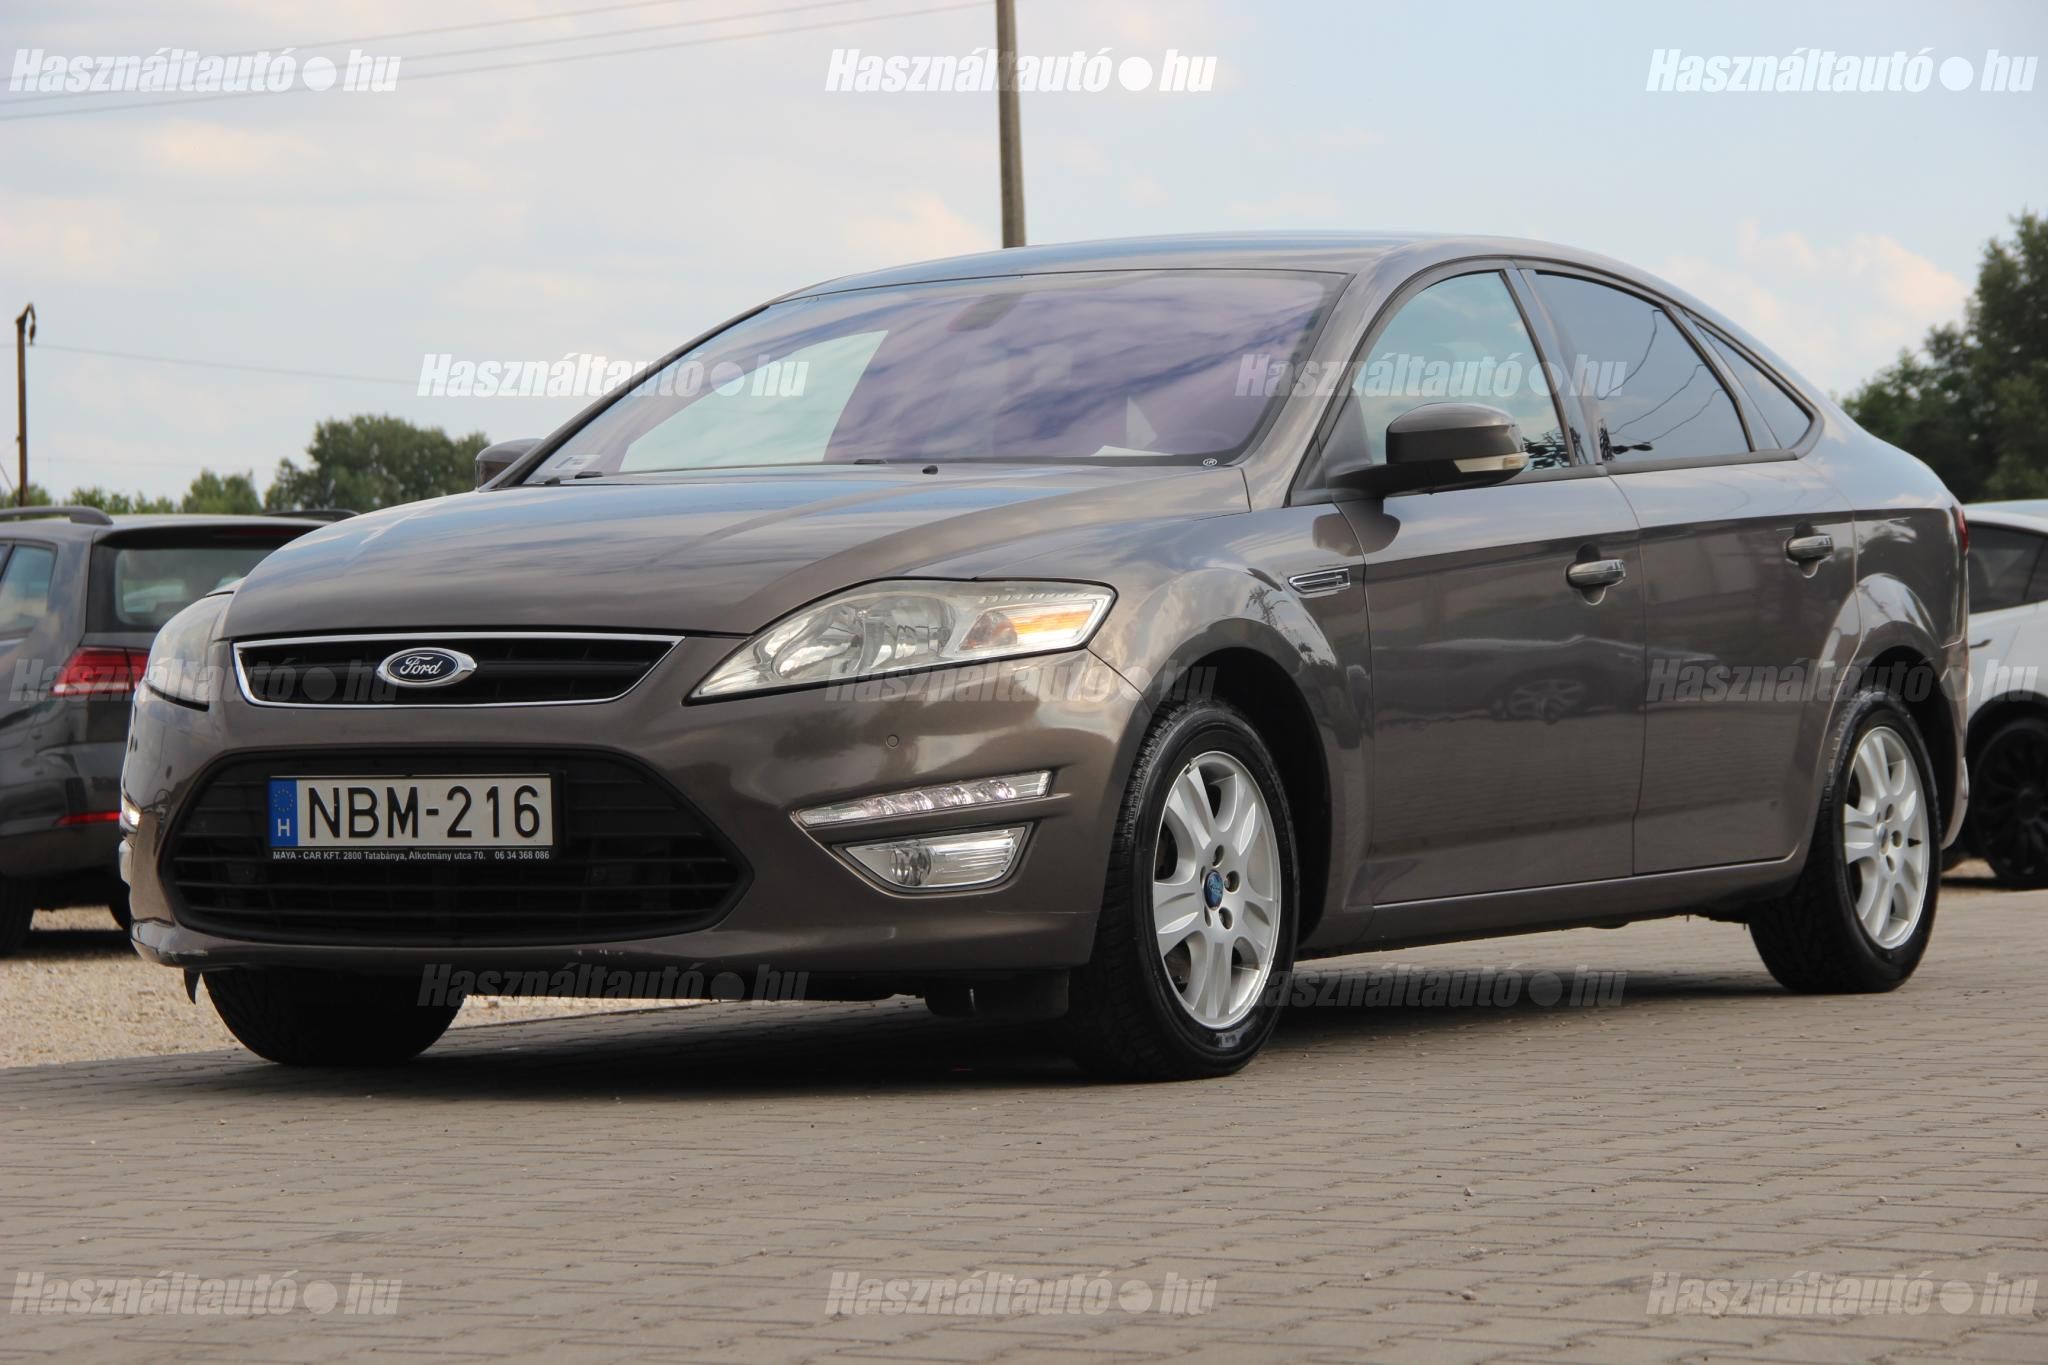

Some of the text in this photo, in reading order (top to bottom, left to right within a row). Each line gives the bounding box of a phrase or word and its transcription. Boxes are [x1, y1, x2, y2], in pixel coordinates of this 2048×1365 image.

[400, 656, 443, 675] Ford
[308, 785, 540, 838] NBM-216
[277, 818, 290, 837] H
[273, 851, 296, 860] MAYA
[303, 851, 322, 860] CAR
[343, 851, 362, 860] 2800
[364, 851, 407, 862] Tatabánya,
[408, 851, 452, 862] Alkotmány
[454, 852, 472, 860] utca
[495, 851, 505, 860] 06
[506, 851, 517, 860] 34
